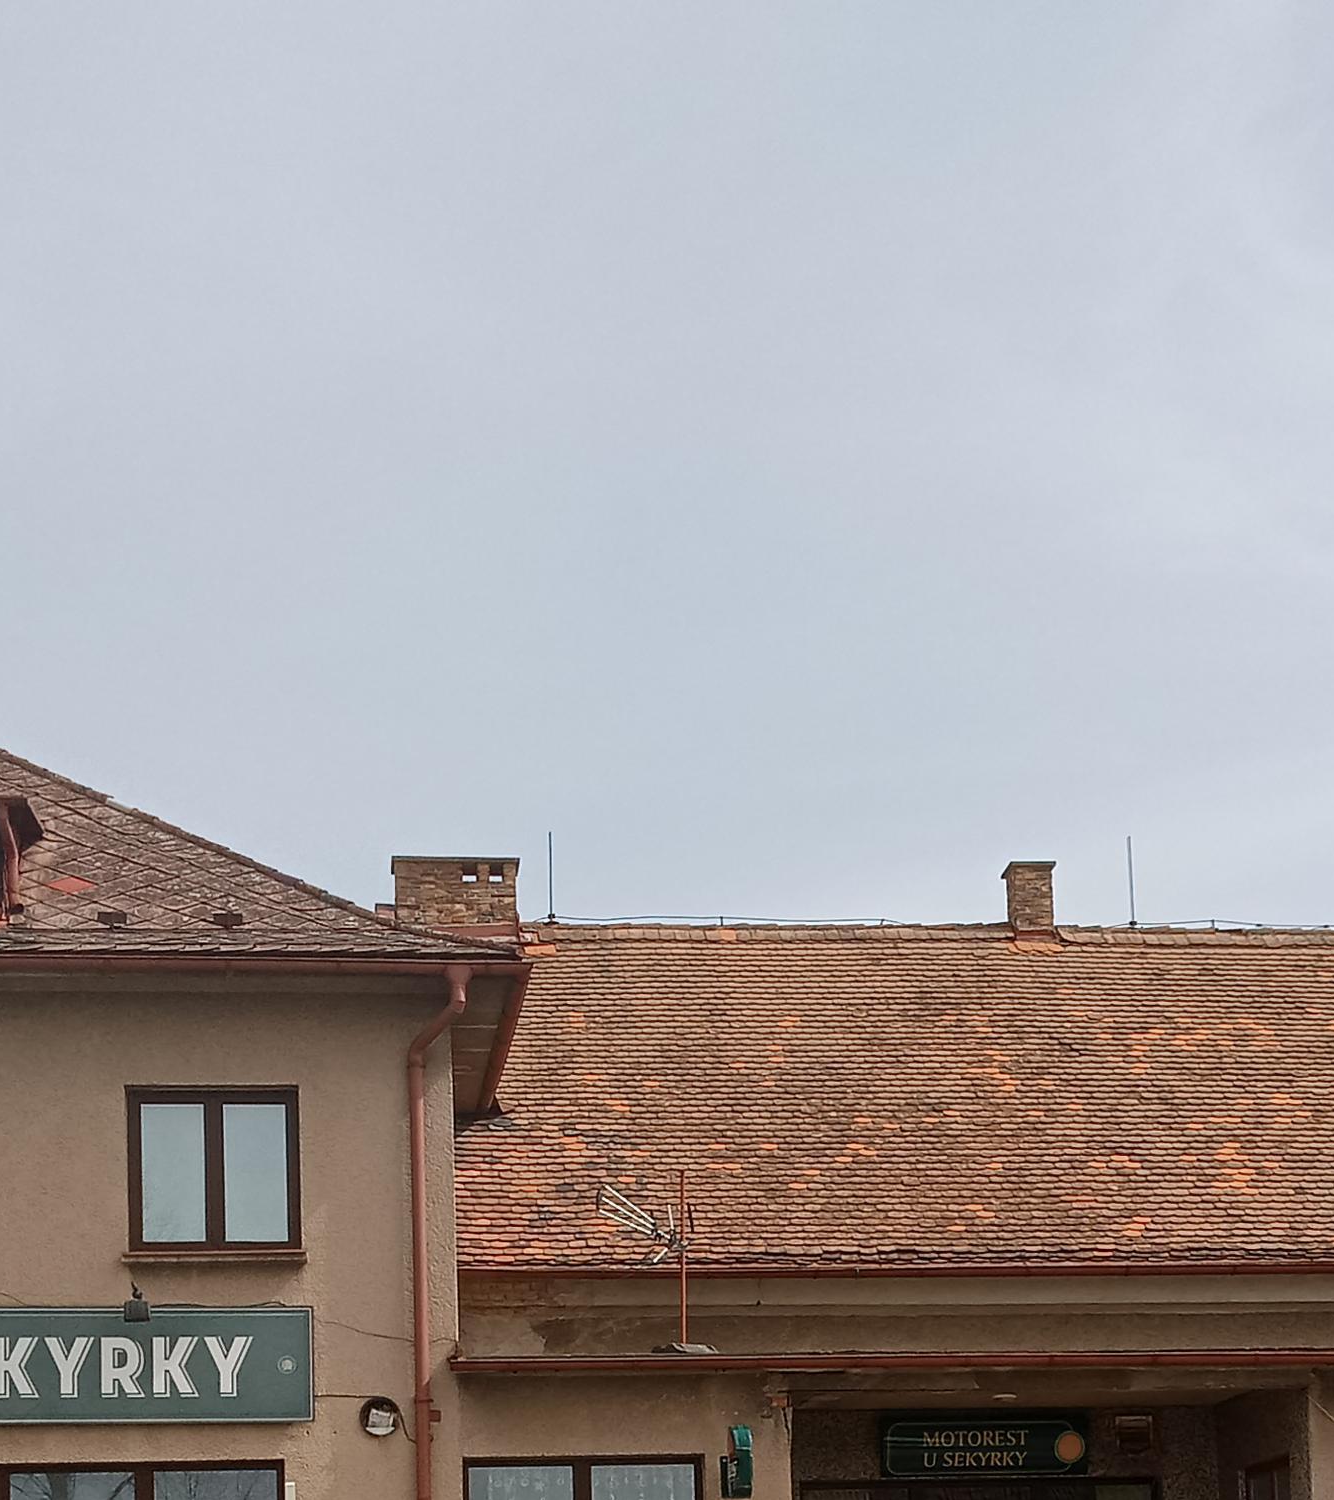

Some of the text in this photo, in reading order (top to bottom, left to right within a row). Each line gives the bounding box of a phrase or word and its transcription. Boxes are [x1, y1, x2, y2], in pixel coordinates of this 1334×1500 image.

[922, 1430, 1029, 1448] MOTOREST
[923, 1451, 1028, 1468] U SEKYRKY
